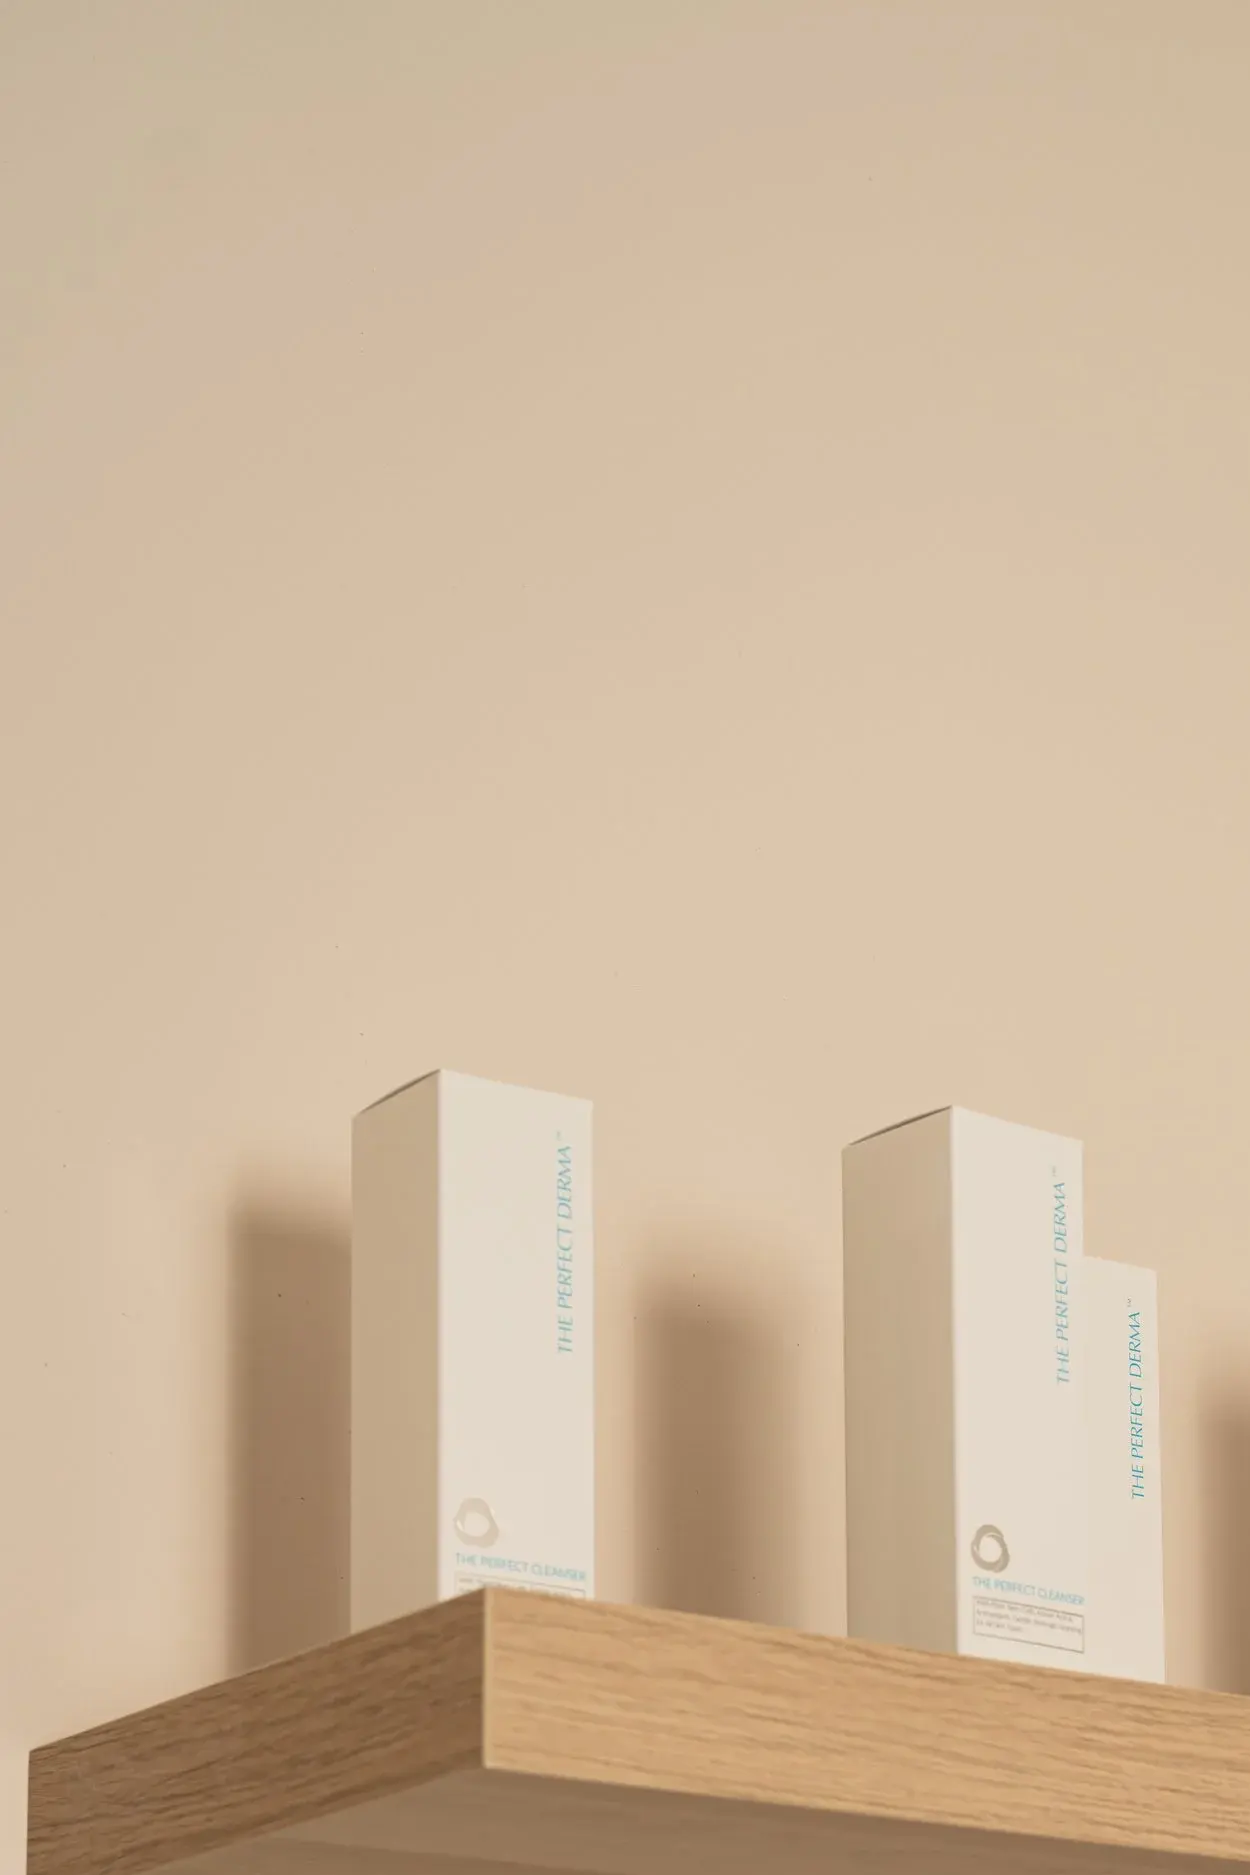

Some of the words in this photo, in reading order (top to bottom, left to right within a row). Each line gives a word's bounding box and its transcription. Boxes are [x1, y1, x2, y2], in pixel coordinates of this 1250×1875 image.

[557, 1224, 573, 1309] PERFECT
[1055, 1258, 1069, 1340] PERFECT
[558, 1315, 573, 1353] THE
[1057, 1345, 1070, 1385] THE
[1129, 1382, 1144, 1459] PERFECT
[1131, 1464, 1145, 1500] THE
